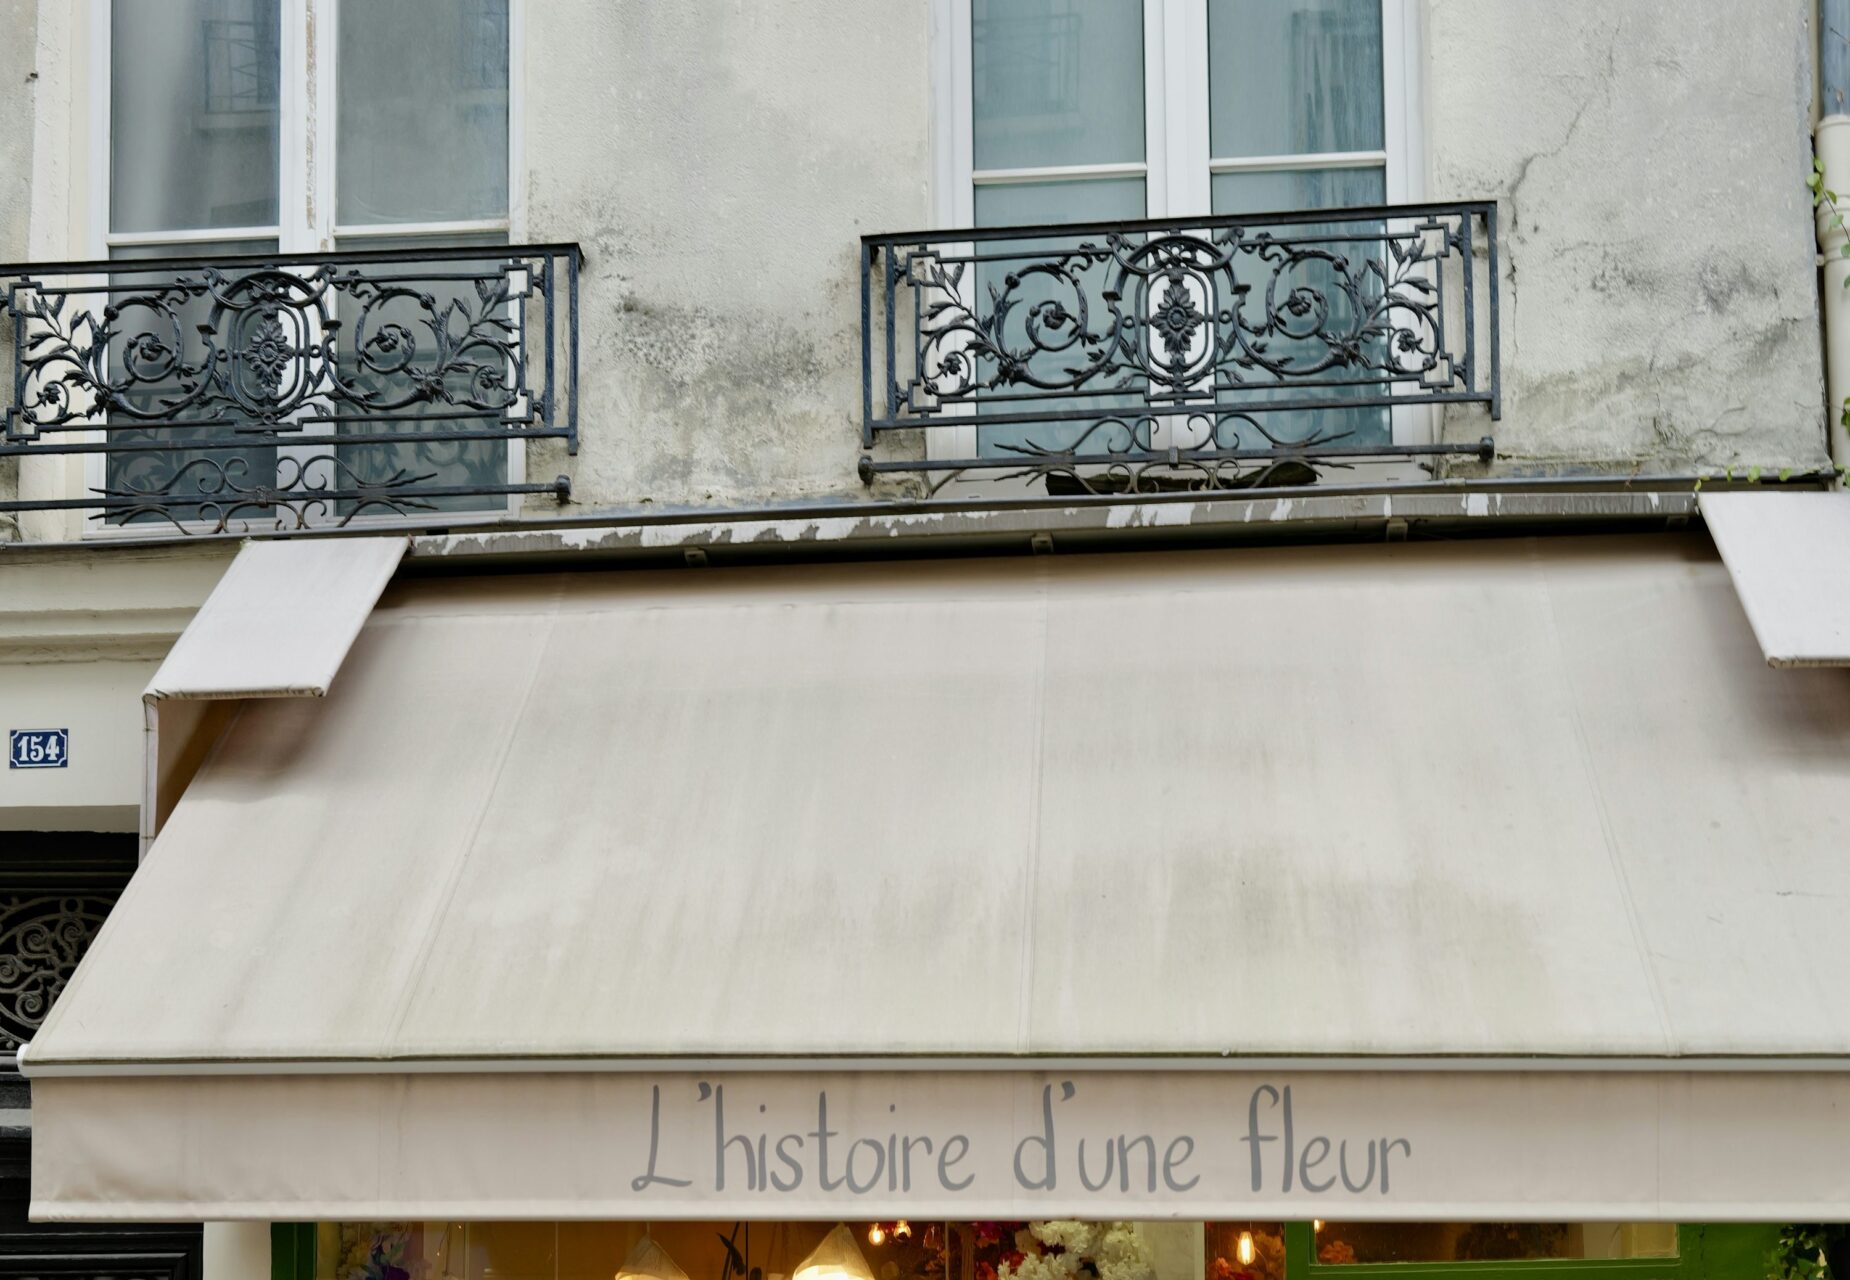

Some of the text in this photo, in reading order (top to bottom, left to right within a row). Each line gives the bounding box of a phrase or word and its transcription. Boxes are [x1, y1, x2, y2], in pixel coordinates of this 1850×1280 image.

[17, 735, 60, 762] 154
[630, 1080, 1412, 1195] L'histoire d'une fleur
